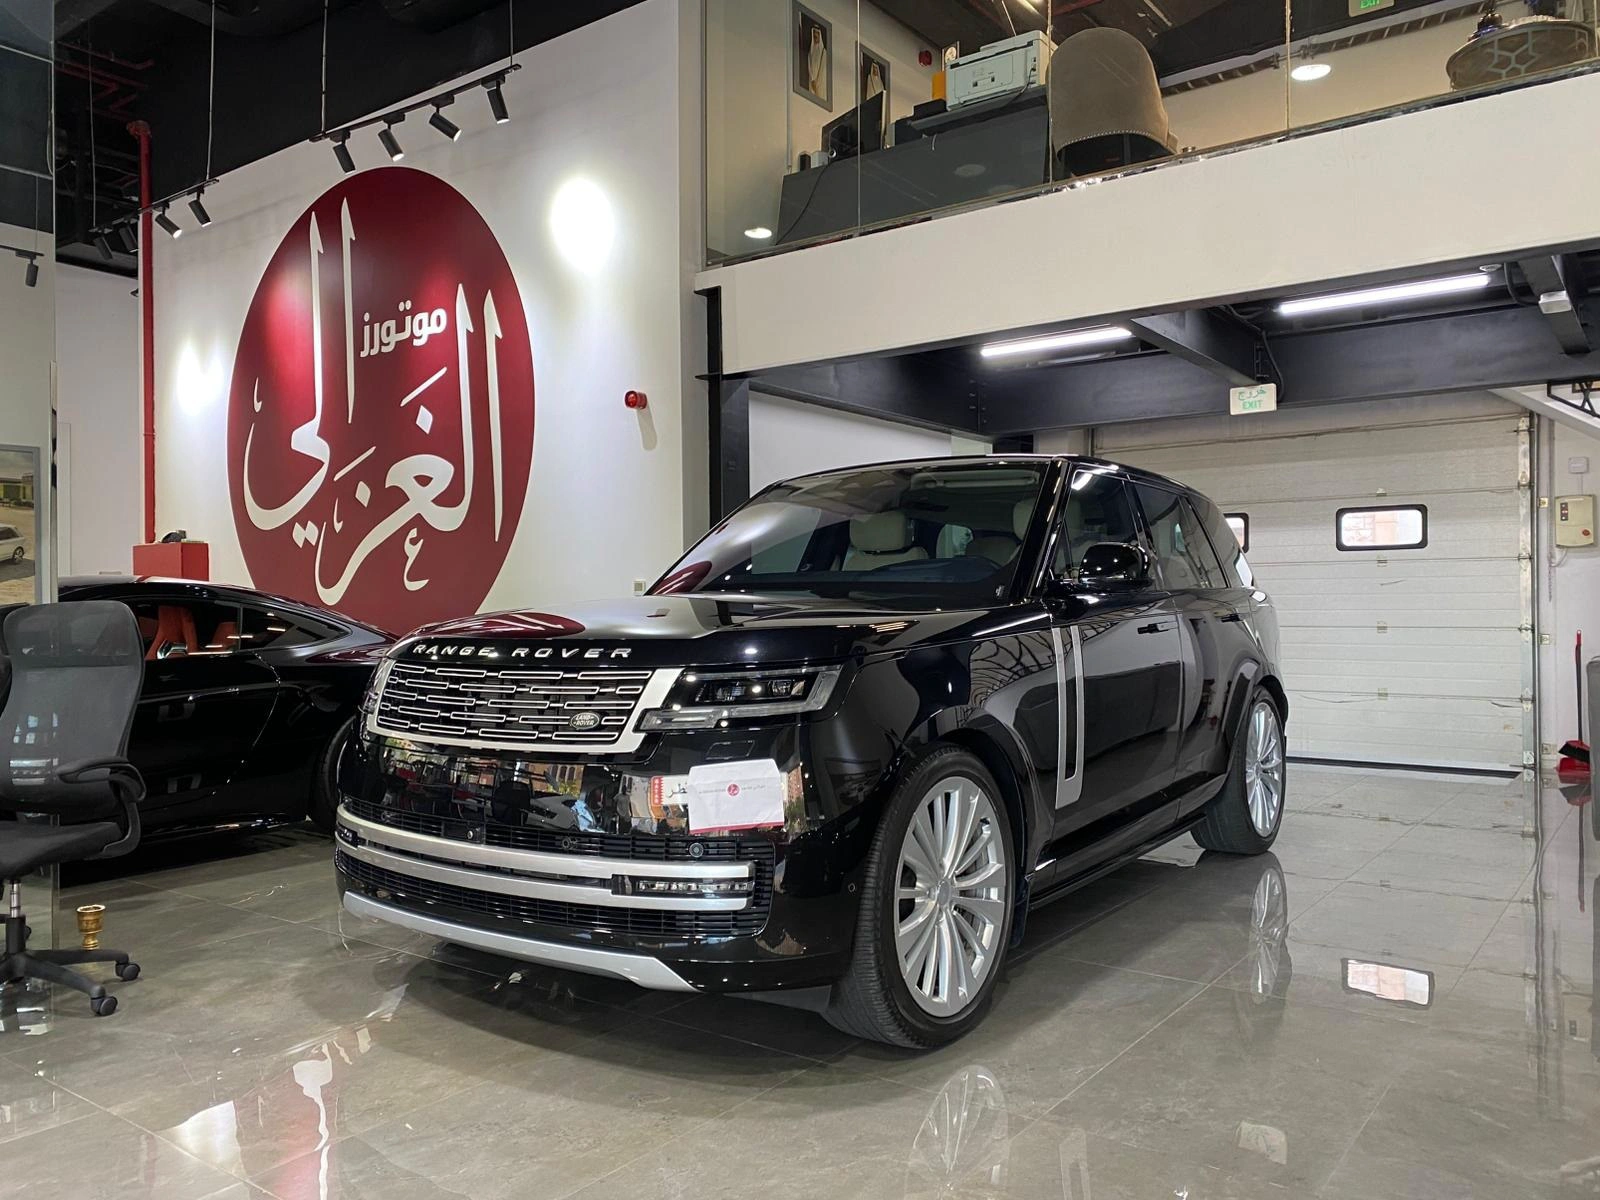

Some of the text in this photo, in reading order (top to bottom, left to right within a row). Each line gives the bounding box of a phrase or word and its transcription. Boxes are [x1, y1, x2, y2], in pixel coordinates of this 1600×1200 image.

[359, 299, 448, 358] موتورز
[1238, 386, 1267, 401] خروج
[1242, 400, 1264, 410] EXIT
[412, 643, 632, 659] RANGE ROVER
